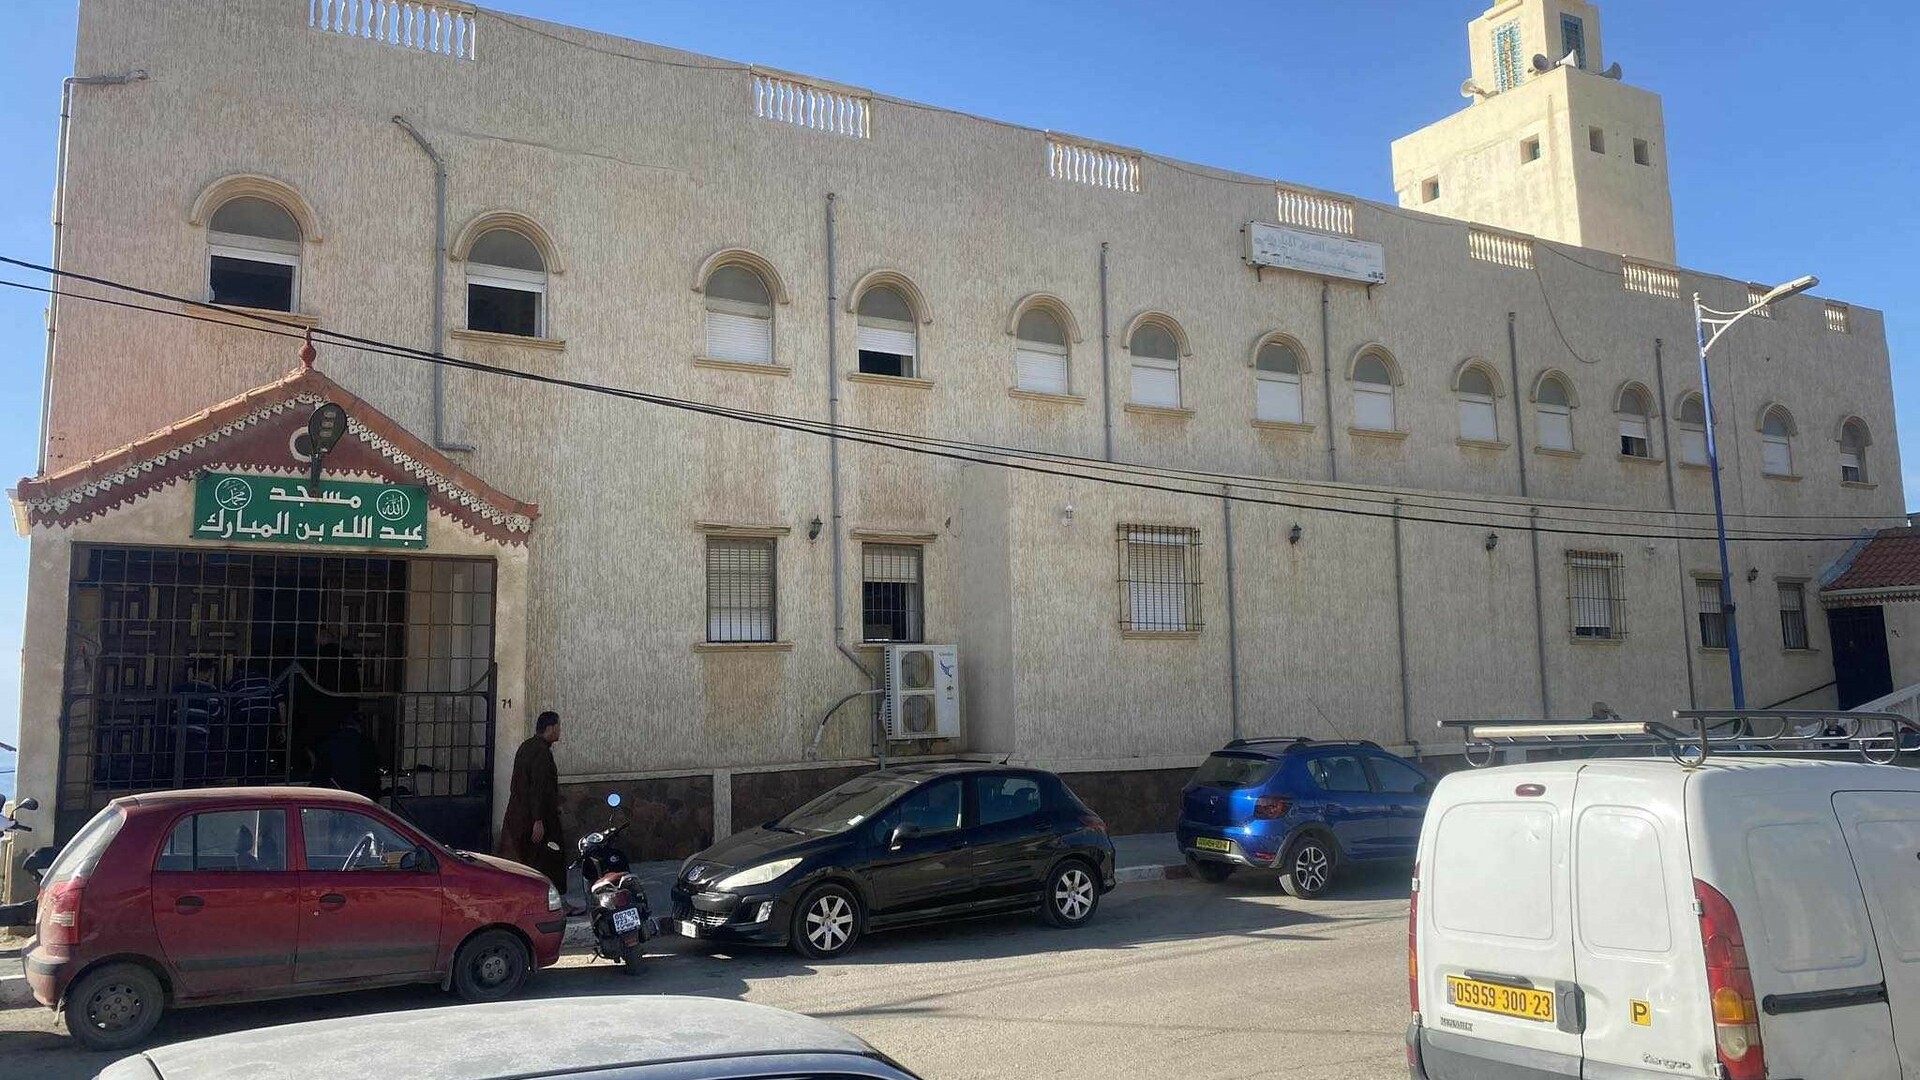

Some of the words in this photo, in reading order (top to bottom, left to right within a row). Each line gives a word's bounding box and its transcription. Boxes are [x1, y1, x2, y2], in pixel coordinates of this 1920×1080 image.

[269, 485, 362, 509] مسجد
[199, 508, 290, 539] المبارك
[295, 522, 325, 542] بن
[332, 515, 373, 539] الله
[379, 524, 423, 546] عبد
[501, 698, 512, 709] 71
[1633, 1002, 1647, 1022] P
